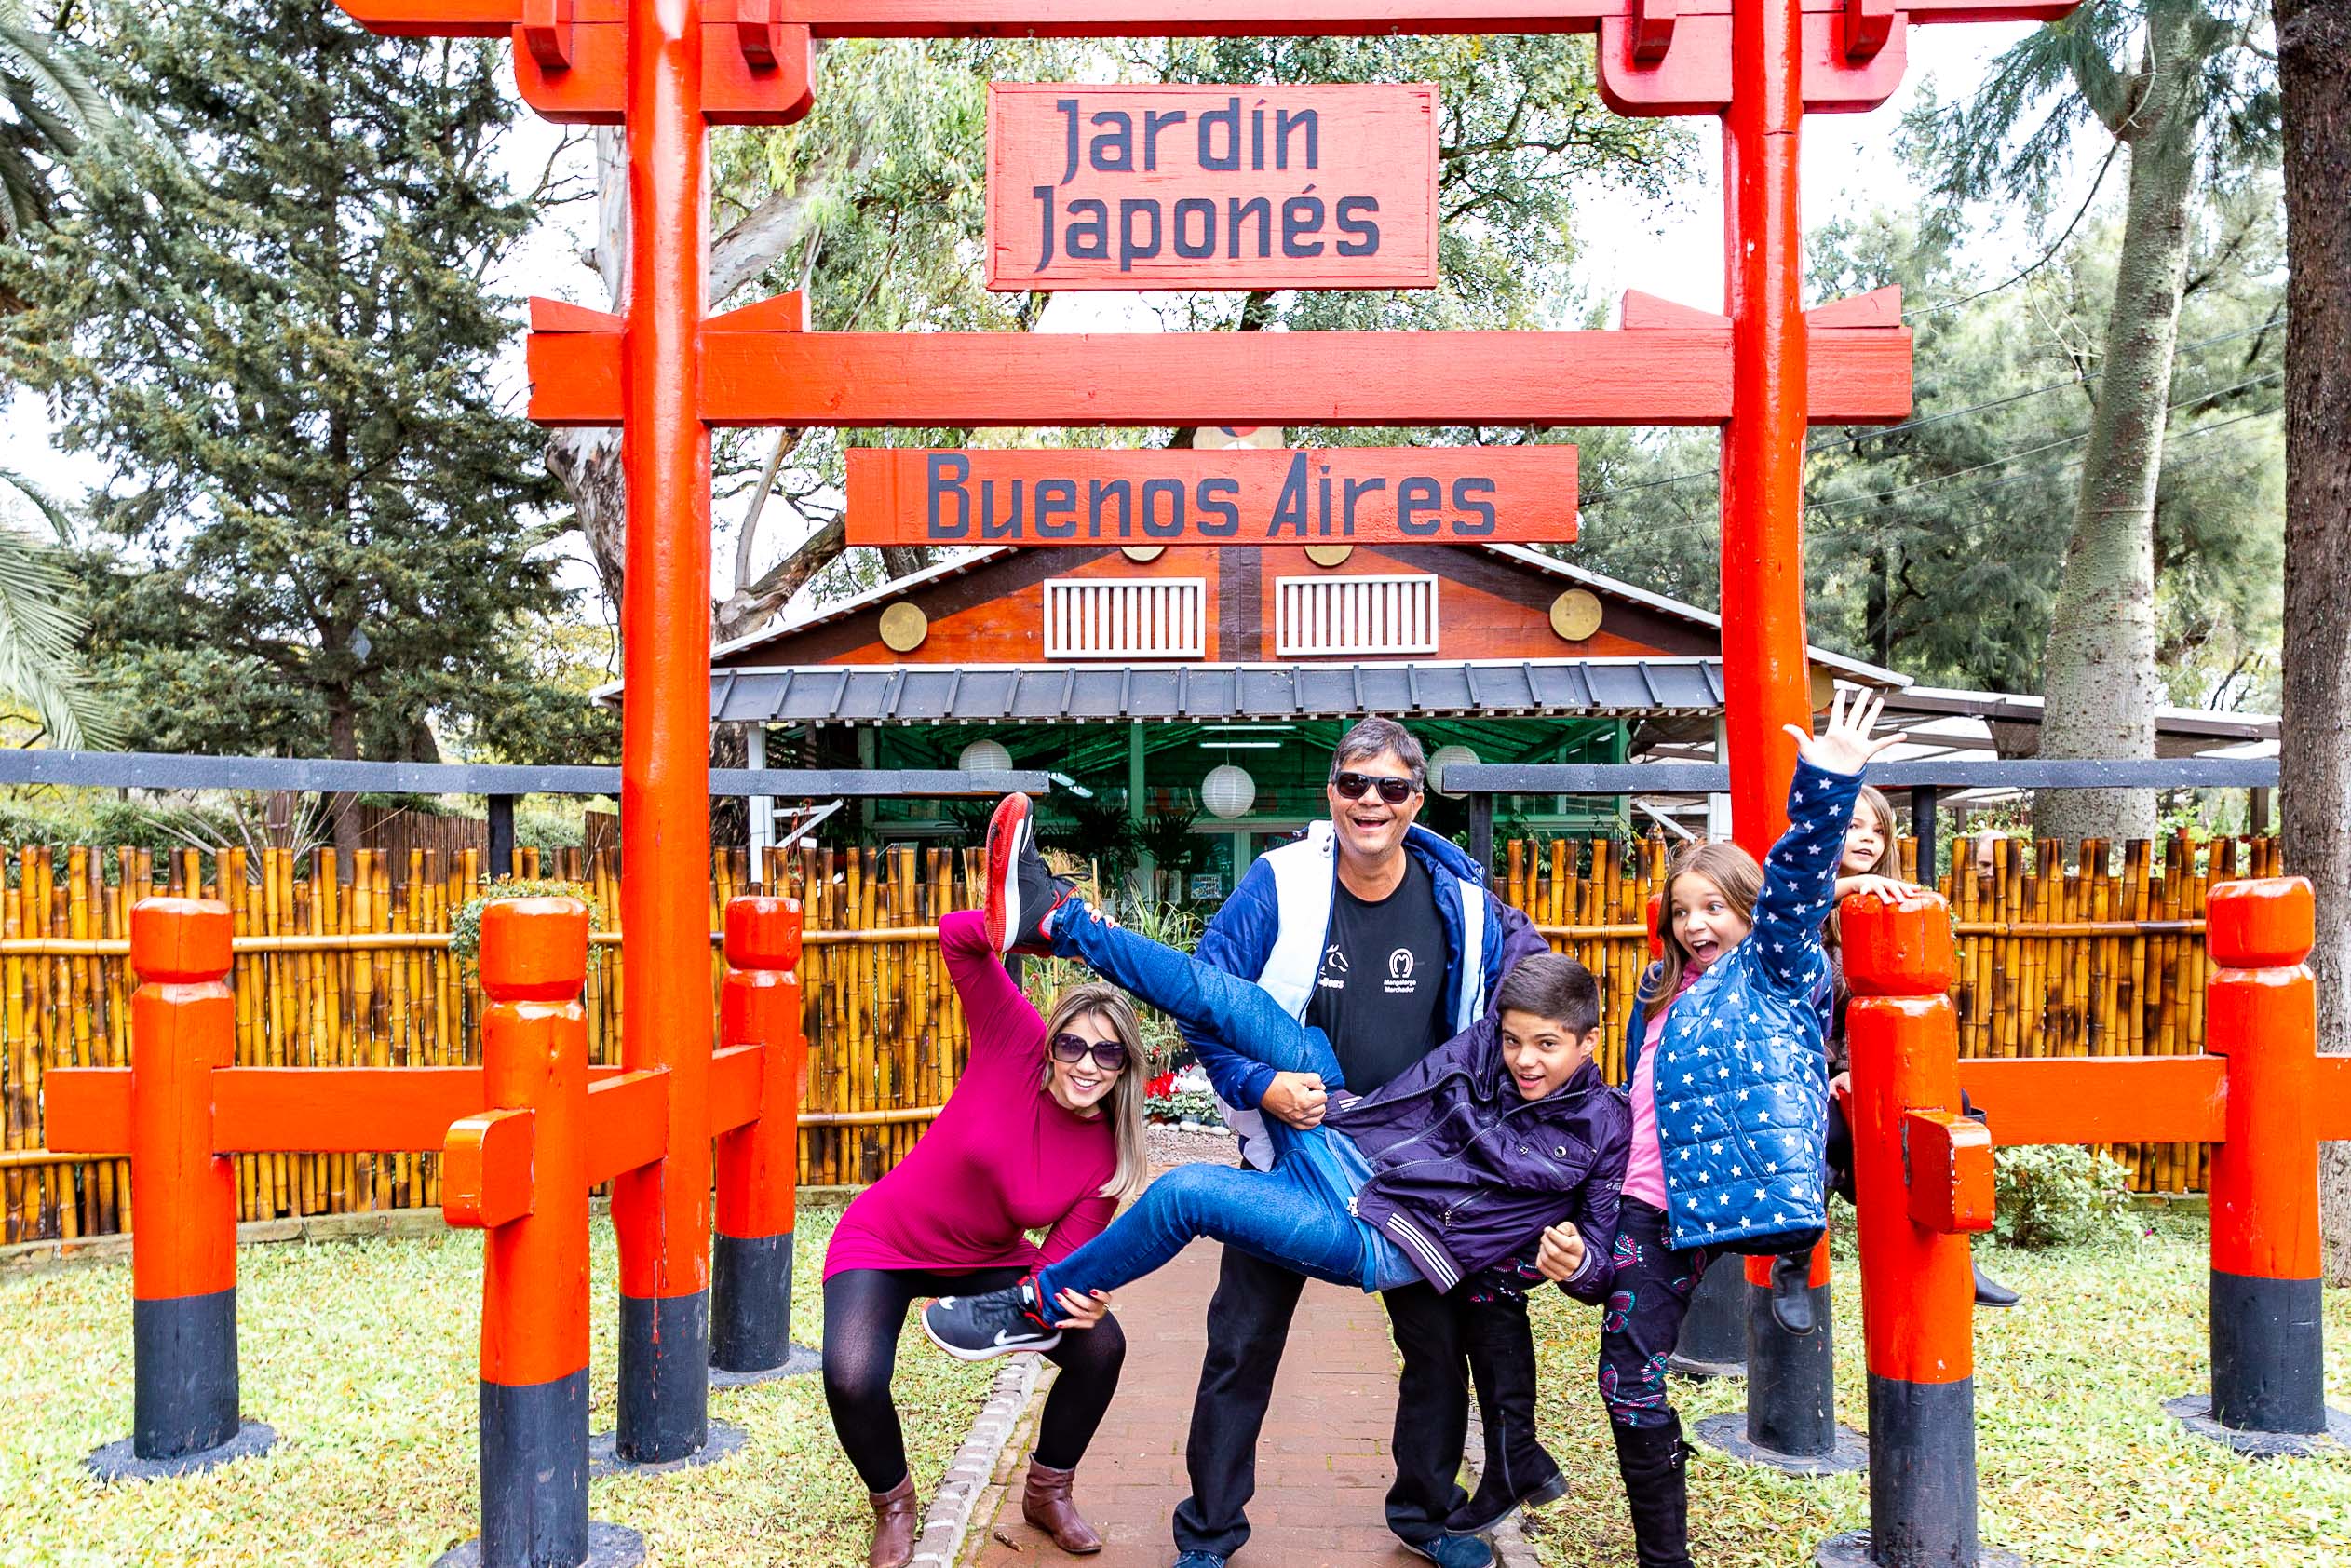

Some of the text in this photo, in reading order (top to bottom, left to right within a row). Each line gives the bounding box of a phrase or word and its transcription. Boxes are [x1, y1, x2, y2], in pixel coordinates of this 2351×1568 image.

[1056, 97, 1319, 185] Jardín
[1033, 183, 1381, 272] Japonés
[927, 452, 1496, 539] Buenos Aires
